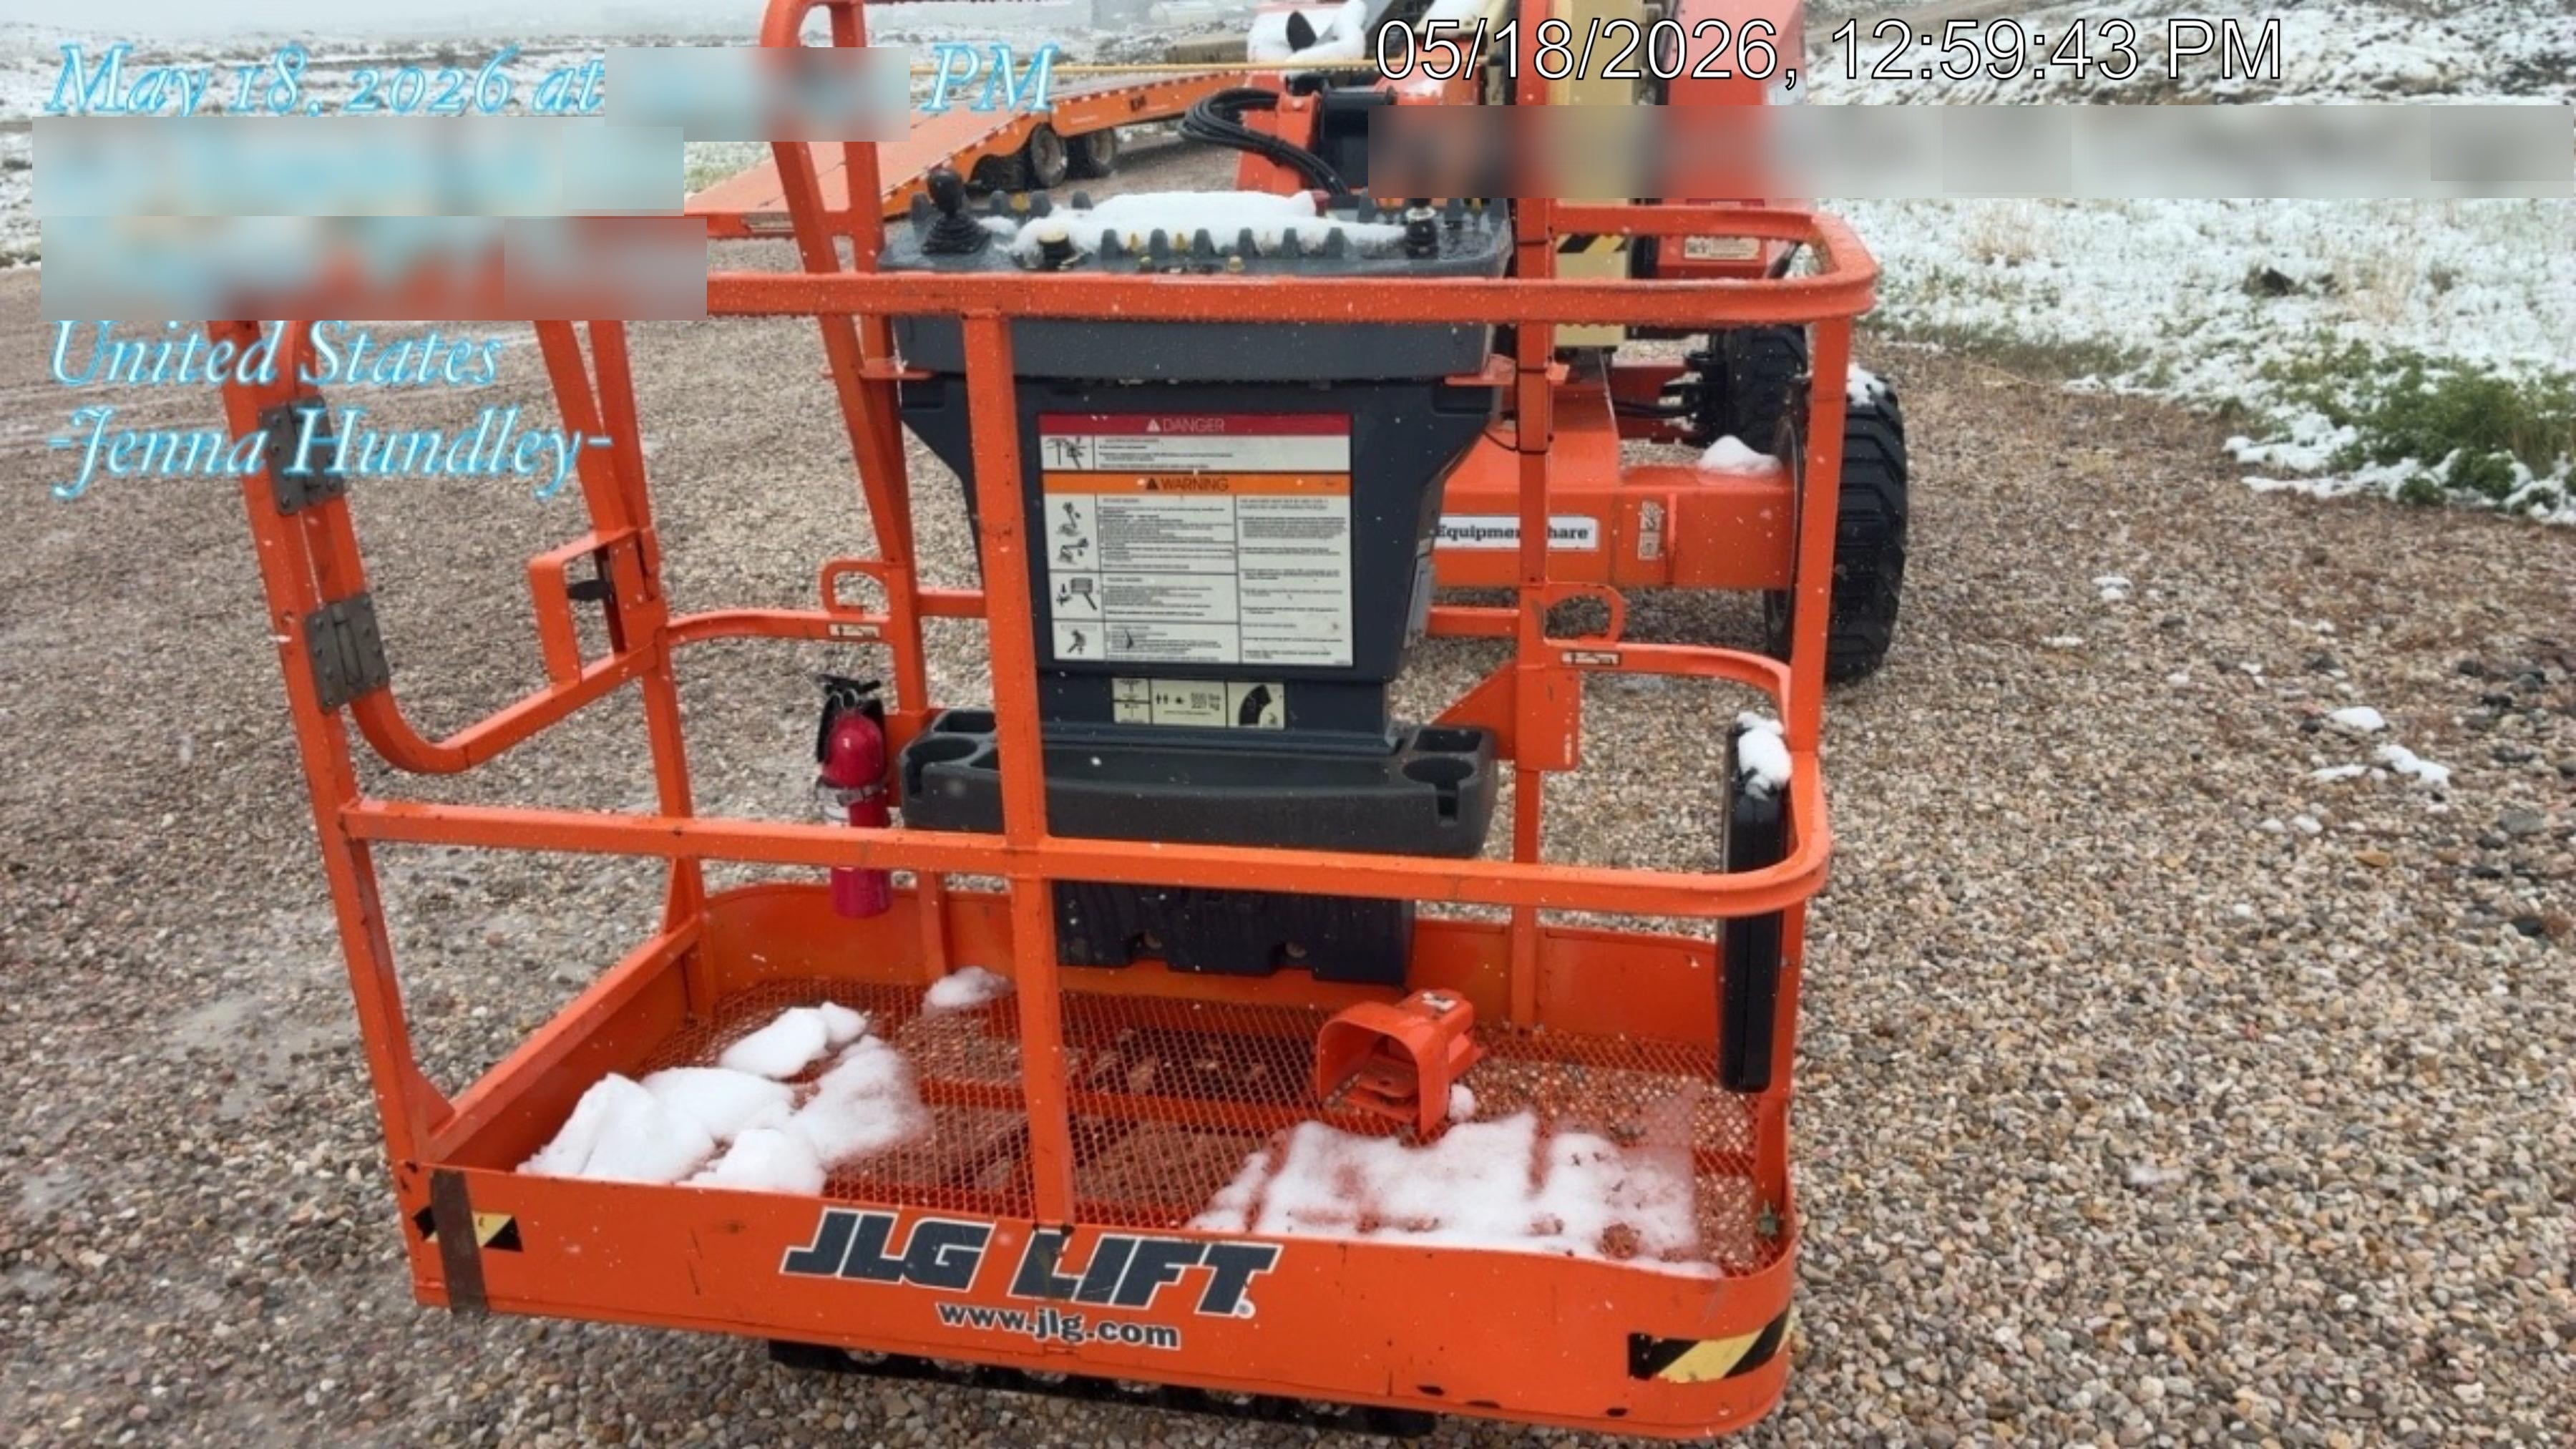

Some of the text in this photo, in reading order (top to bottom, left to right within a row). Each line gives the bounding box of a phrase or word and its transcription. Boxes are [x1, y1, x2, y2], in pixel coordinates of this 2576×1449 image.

[1163, 417, 1225, 432] DANGER
[1160, 477, 1229, 492] WARNING
[779, 1206, 997, 1293] JLG
[935, 1302, 1181, 1351] www.jlg.com
